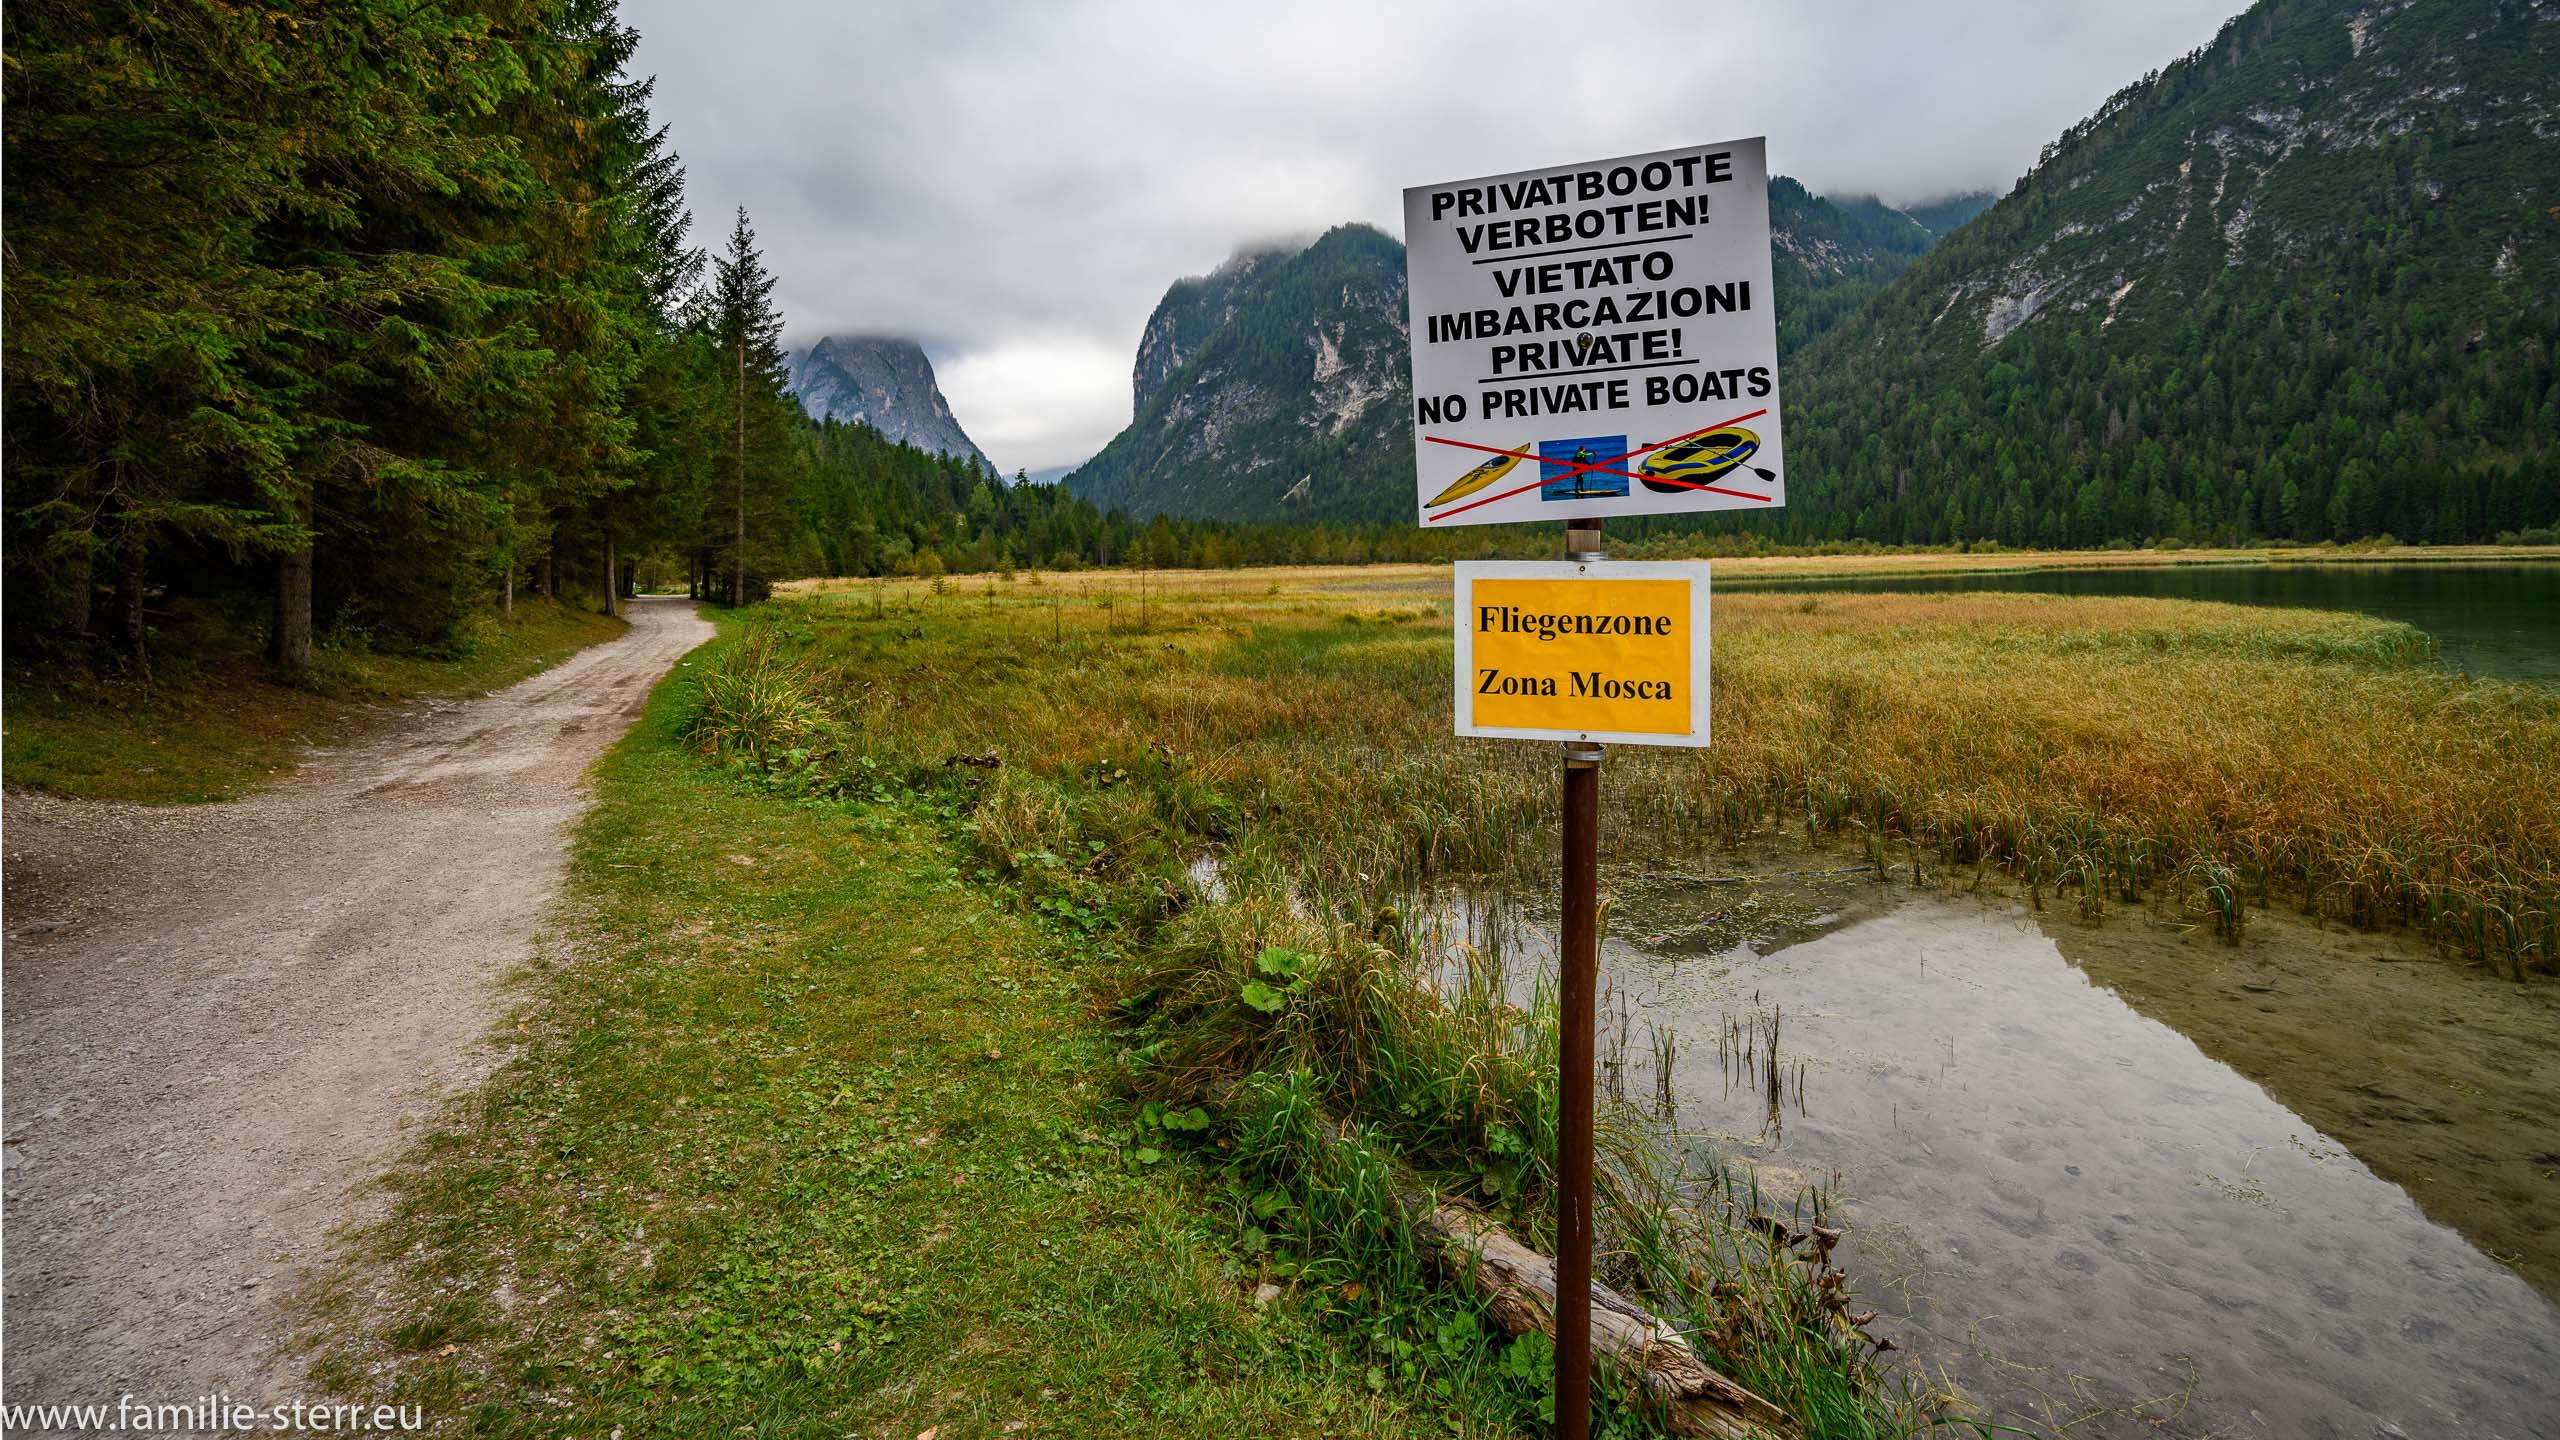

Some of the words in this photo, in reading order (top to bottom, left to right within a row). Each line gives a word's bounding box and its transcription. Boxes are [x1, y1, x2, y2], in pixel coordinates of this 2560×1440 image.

[1431, 152, 1733, 221] PRIVATBOOTE
[1456, 194, 1710, 254] VERBOTEN!
[1492, 251, 1674, 298] VIETATO
[1428, 281, 1751, 343] IMBARCAZIONI
[1492, 328, 1683, 375] PRIVATE!
[1418, 394, 1467, 426] NO
[1483, 379, 1630, 420] PRIVATE
[1645, 366, 1771, 407] BOATS
[1478, 606, 1672, 641] Fliegenzone
[1478, 669, 1558, 697] Zona
[1568, 671, 1673, 700] Mosca
